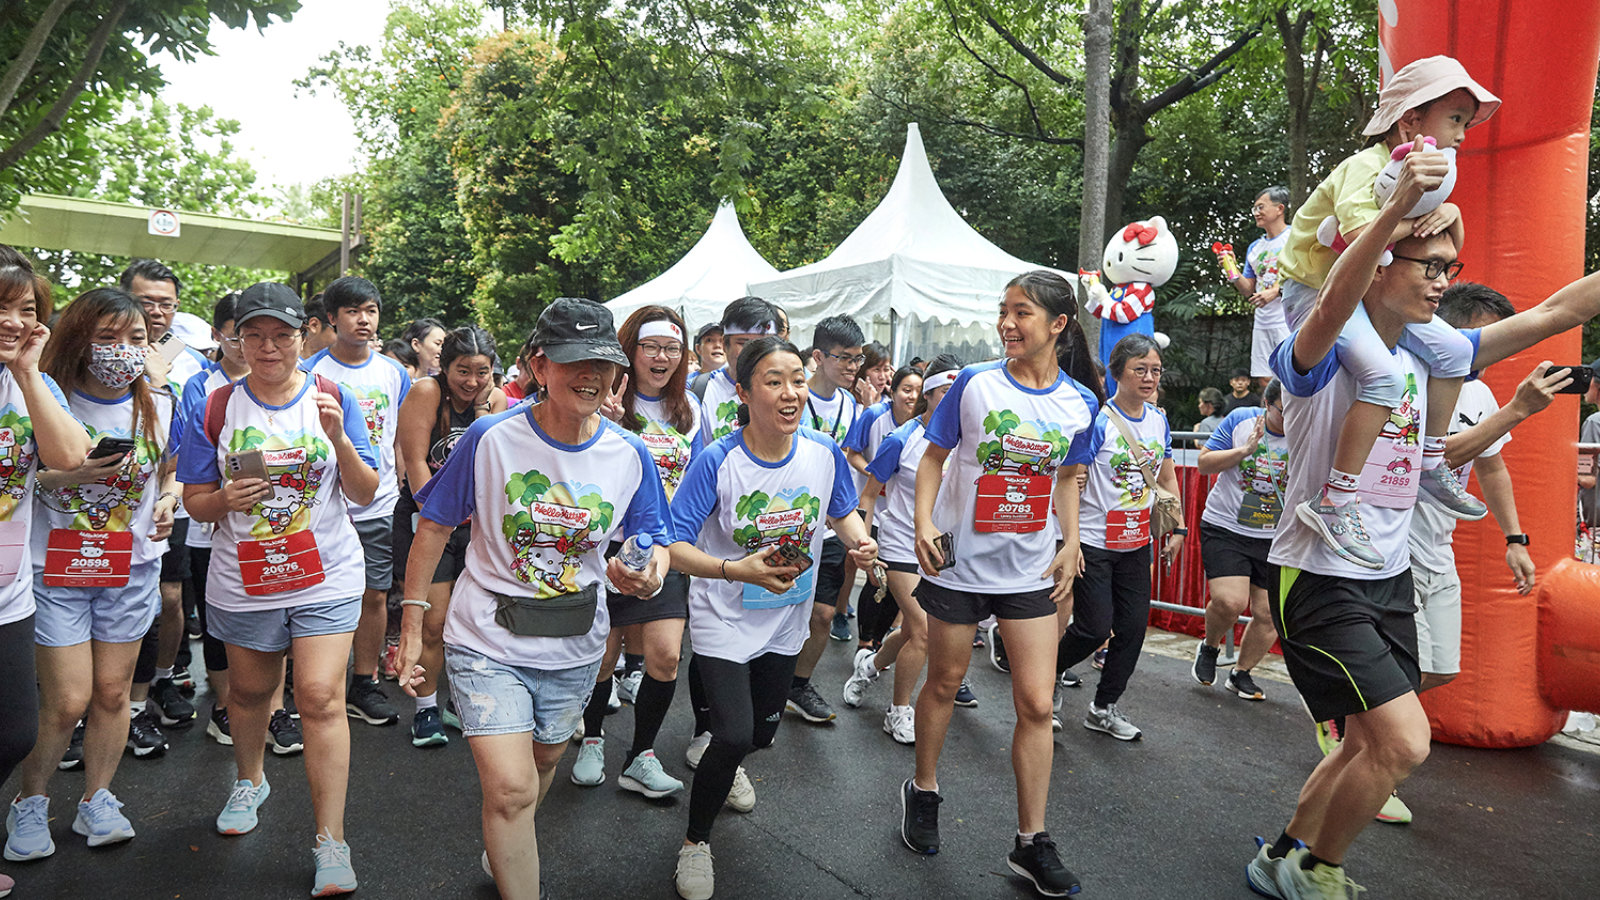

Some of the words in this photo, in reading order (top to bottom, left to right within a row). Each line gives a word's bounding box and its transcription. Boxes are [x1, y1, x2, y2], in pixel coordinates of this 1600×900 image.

[1005, 436, 1026, 448] Hello
[1026, 442, 1049, 452] Kitty
[1380, 475, 1410, 486] 21859
[534, 503, 560, 517] Hello
[560, 508, 587, 522] Kitty
[998, 503, 1031, 512] 20783
[71, 558, 110, 567] 20598
[262, 562, 299, 575] 20676
